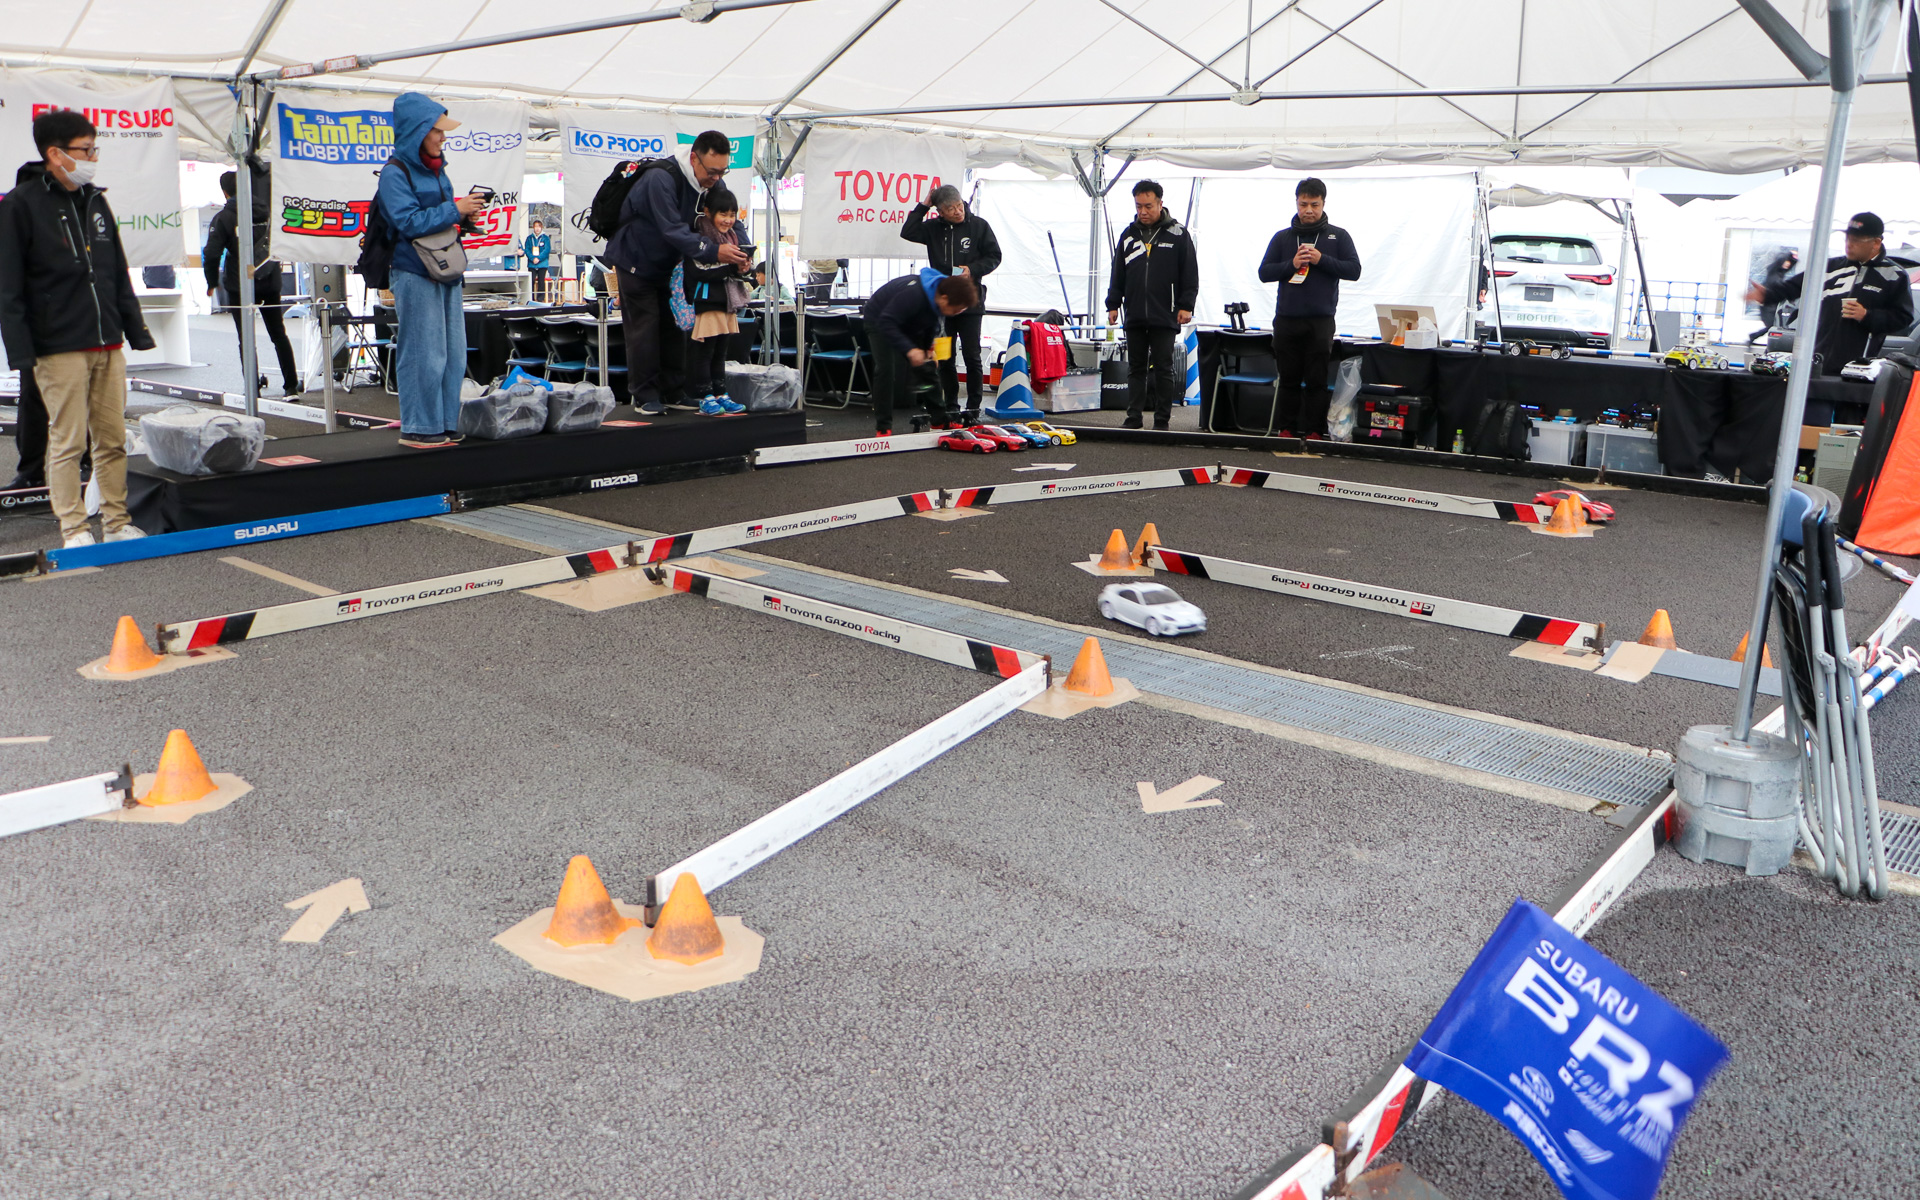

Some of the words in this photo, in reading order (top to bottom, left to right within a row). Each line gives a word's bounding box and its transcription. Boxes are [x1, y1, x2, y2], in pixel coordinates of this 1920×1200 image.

[285, 109, 395, 145] TamTam
[575, 131, 604, 148] KO
[607, 135, 664, 153] PROPO
[288, 140, 351, 161] HOBBY
[283, 197, 301, 207] RC
[302, 198, 347, 210] Paradise
[856, 208, 875, 222] RC
[880, 210, 905, 223] CAR
[1516, 313, 1557, 323] BIOFUEL
[855, 441, 890, 453] TOYOTA
[590, 473, 638, 488] mazda
[1057, 485, 1087, 493] TOYOTA
[1088, 482, 1115, 490] GAZOO
[16, 495, 56, 504] LEXU
[1336, 487, 1372, 497] TOYOTA
[1373, 492, 1406, 502] GAZOO
[1407, 497, 1439, 507] Racing
[234, 521, 299, 540] SUBARU
[764, 523, 798, 534] TOYOTA
[800, 518, 830, 528] GAZOO
[831, 513, 857, 523] Racing
[1271, 574, 1310, 590] Racing
[365, 594, 416, 609] TOYOTA
[418, 585, 462, 599] GAZOO
[464, 578, 504, 591] Racing
[1312, 584, 1356, 598] GAZOO
[1358, 592, 1408, 607] TOYOTA
[783, 604, 823, 621] TOYOTA
[824, 615, 862, 632] GAZOO
[864, 625, 901, 643] Racing
[1535, 939, 1639, 1025] SUBARU
